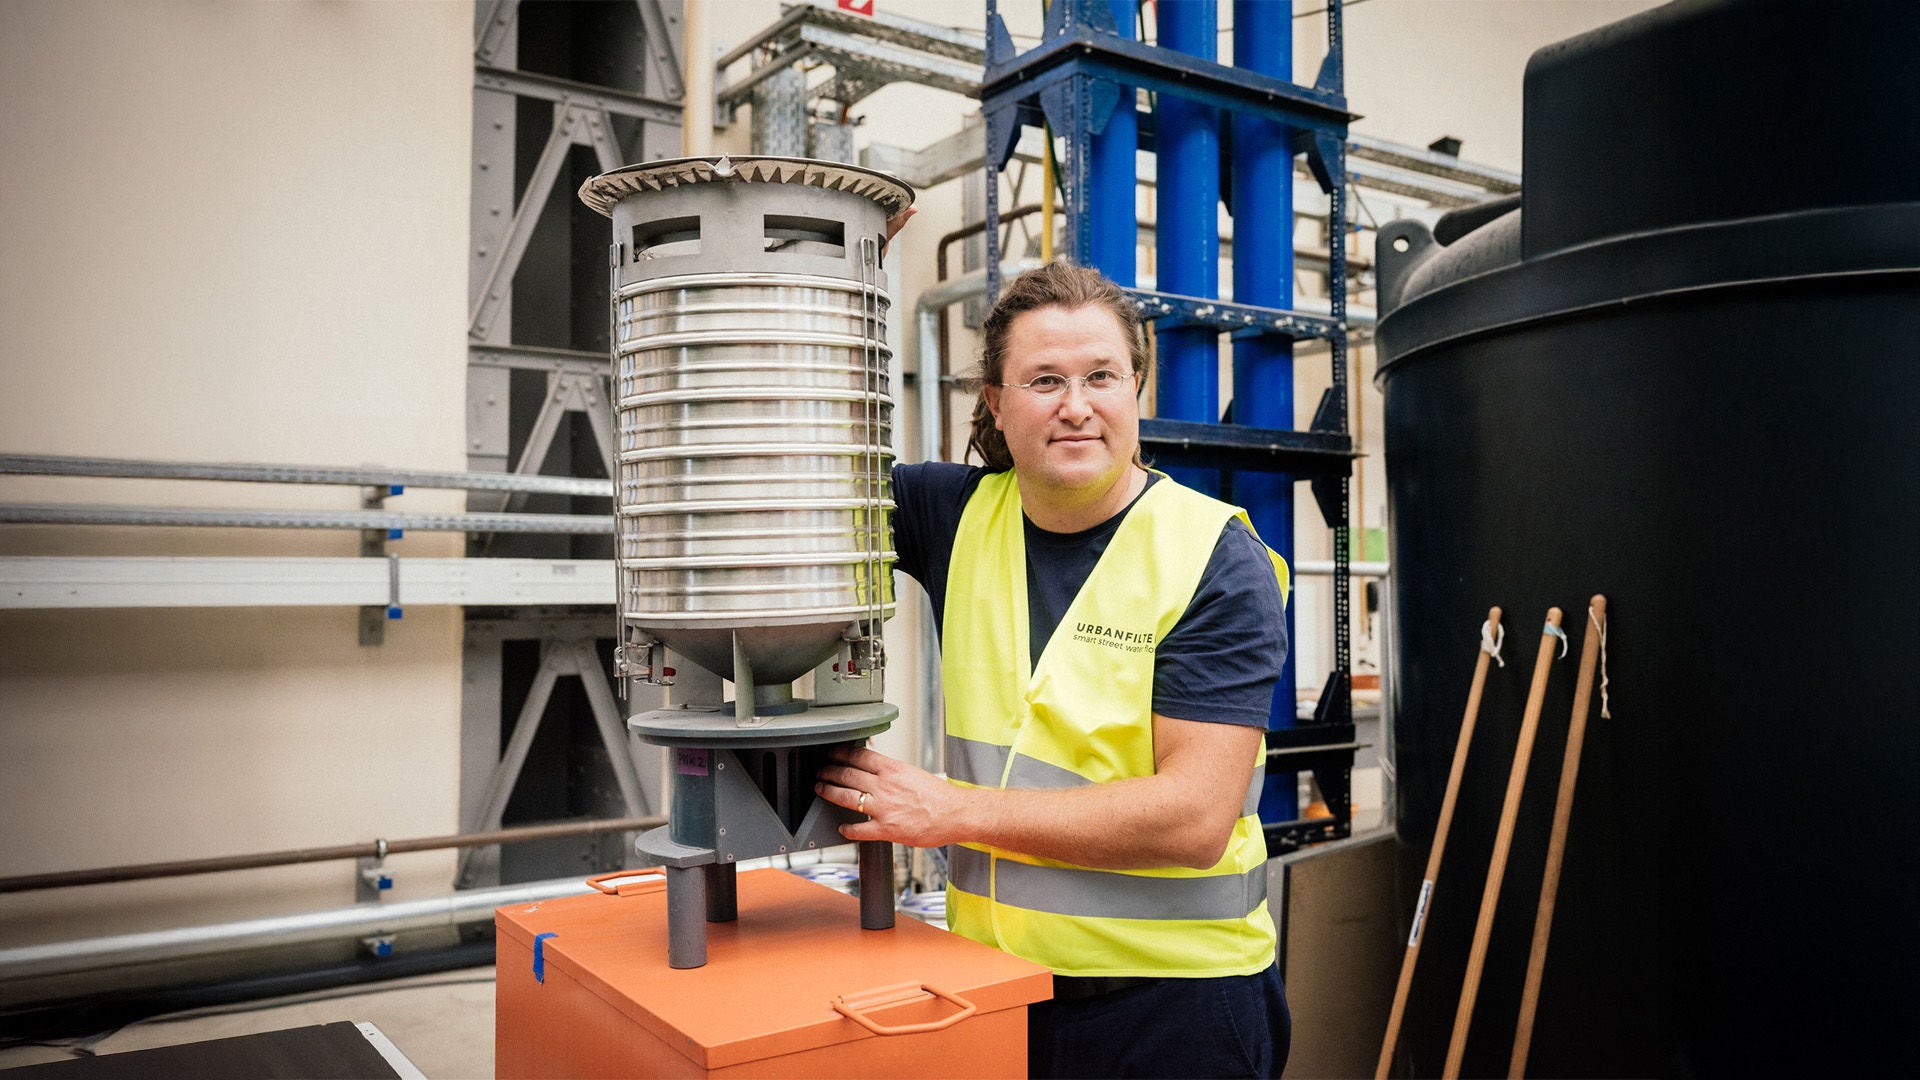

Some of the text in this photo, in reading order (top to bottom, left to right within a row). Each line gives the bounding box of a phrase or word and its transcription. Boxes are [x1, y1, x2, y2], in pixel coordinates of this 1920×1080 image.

[1073, 634, 1097, 645] smart
[1098, 638, 1124, 650] street
[1076, 622, 1156, 644] URBANFILTE
